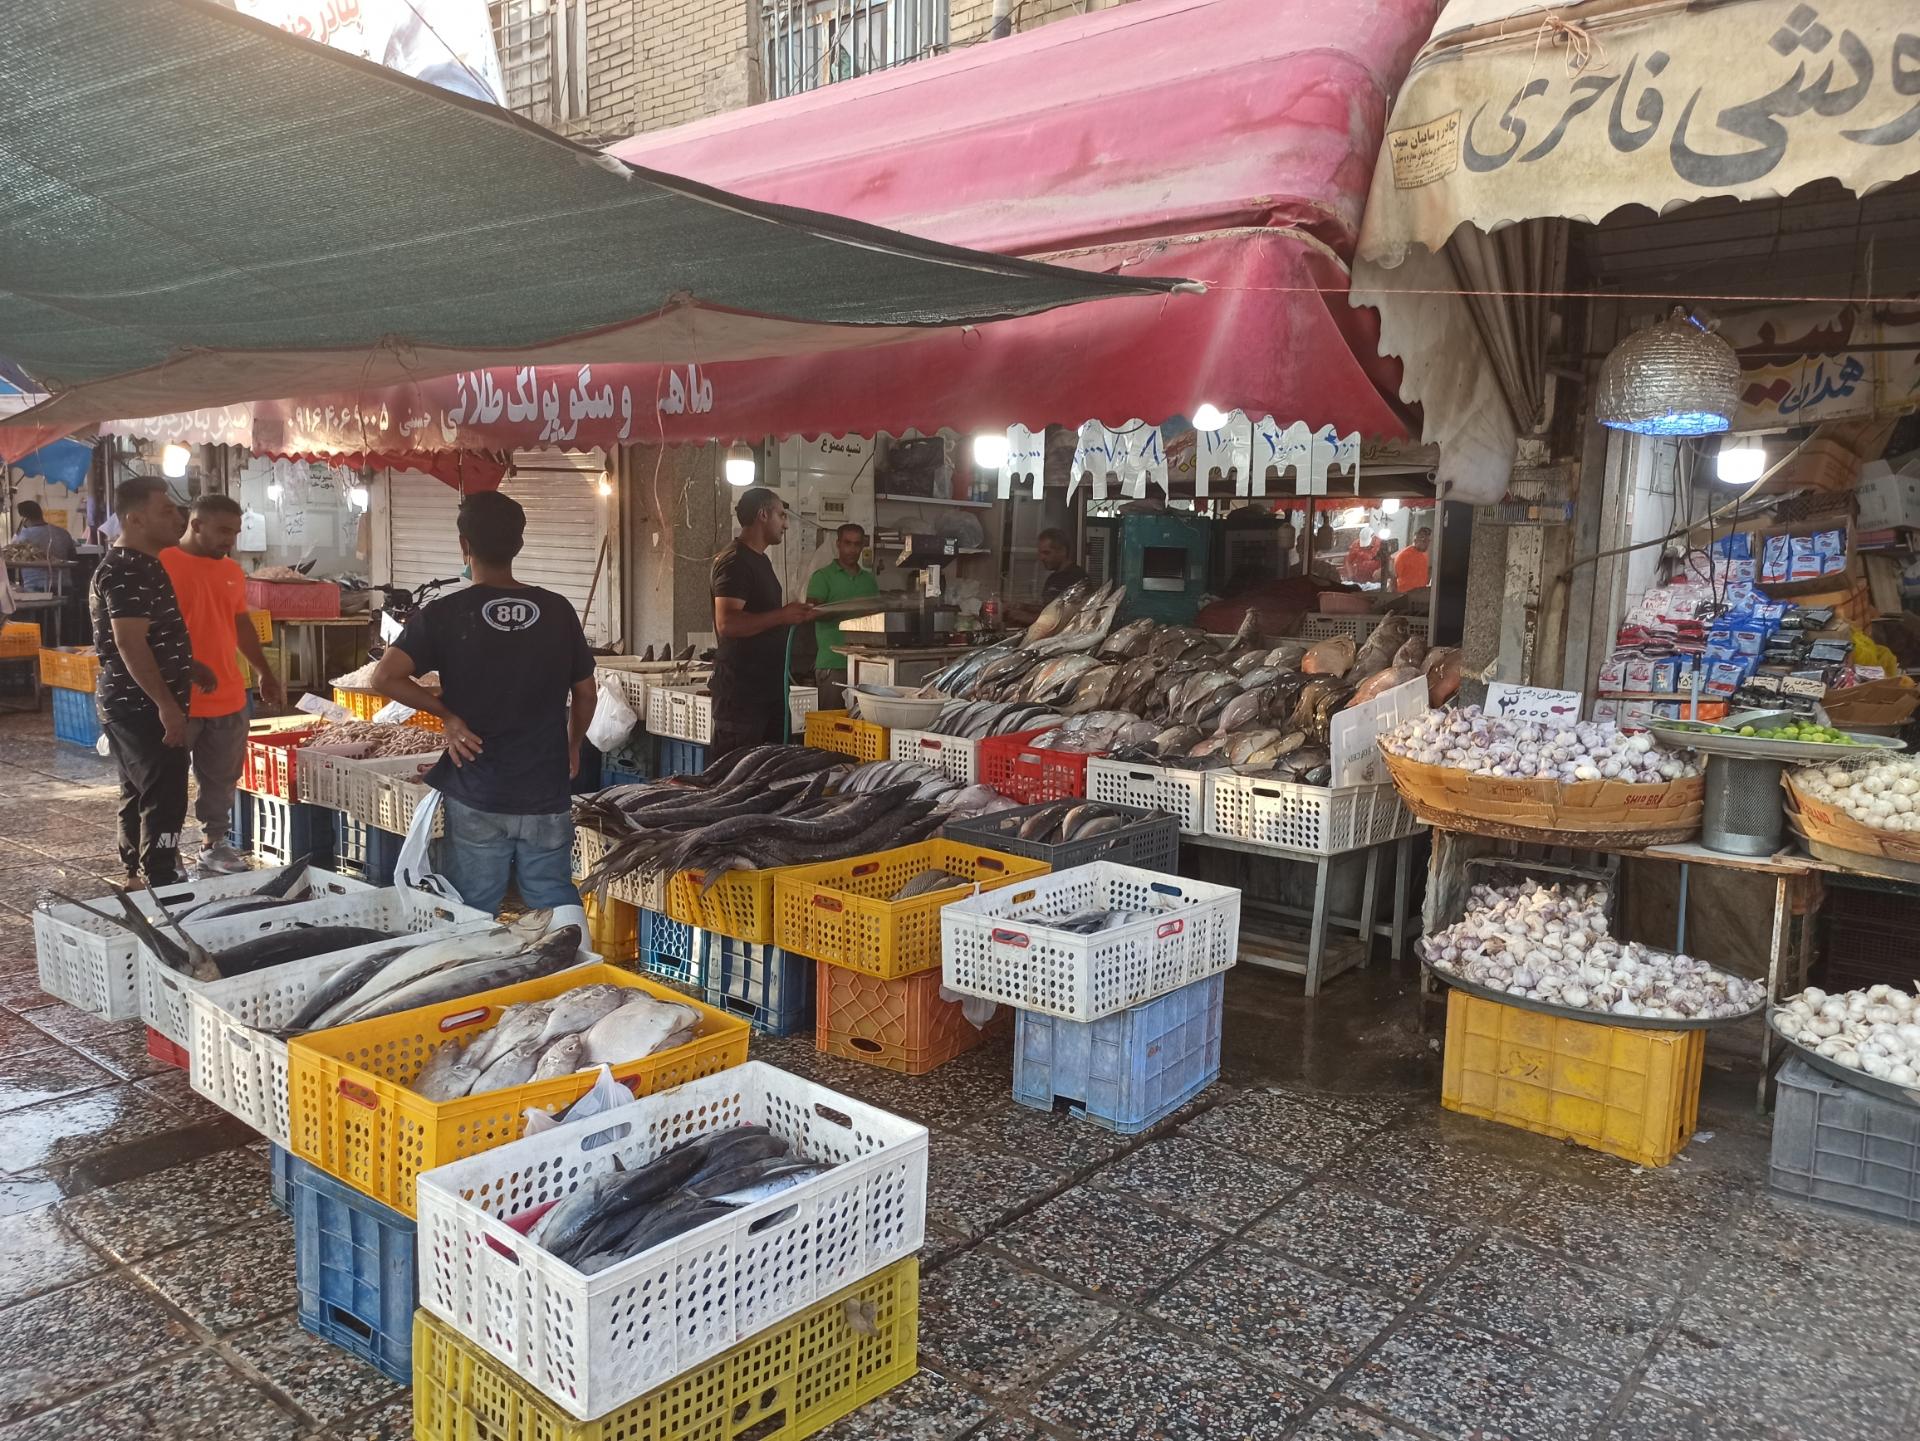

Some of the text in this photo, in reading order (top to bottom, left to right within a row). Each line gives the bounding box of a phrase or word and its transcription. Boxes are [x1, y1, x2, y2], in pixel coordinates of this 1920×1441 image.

[1463, 49, 1670, 172] فاخری
[1778, 355, 1864, 415] همدان
[497, 605, 526, 623] 80
